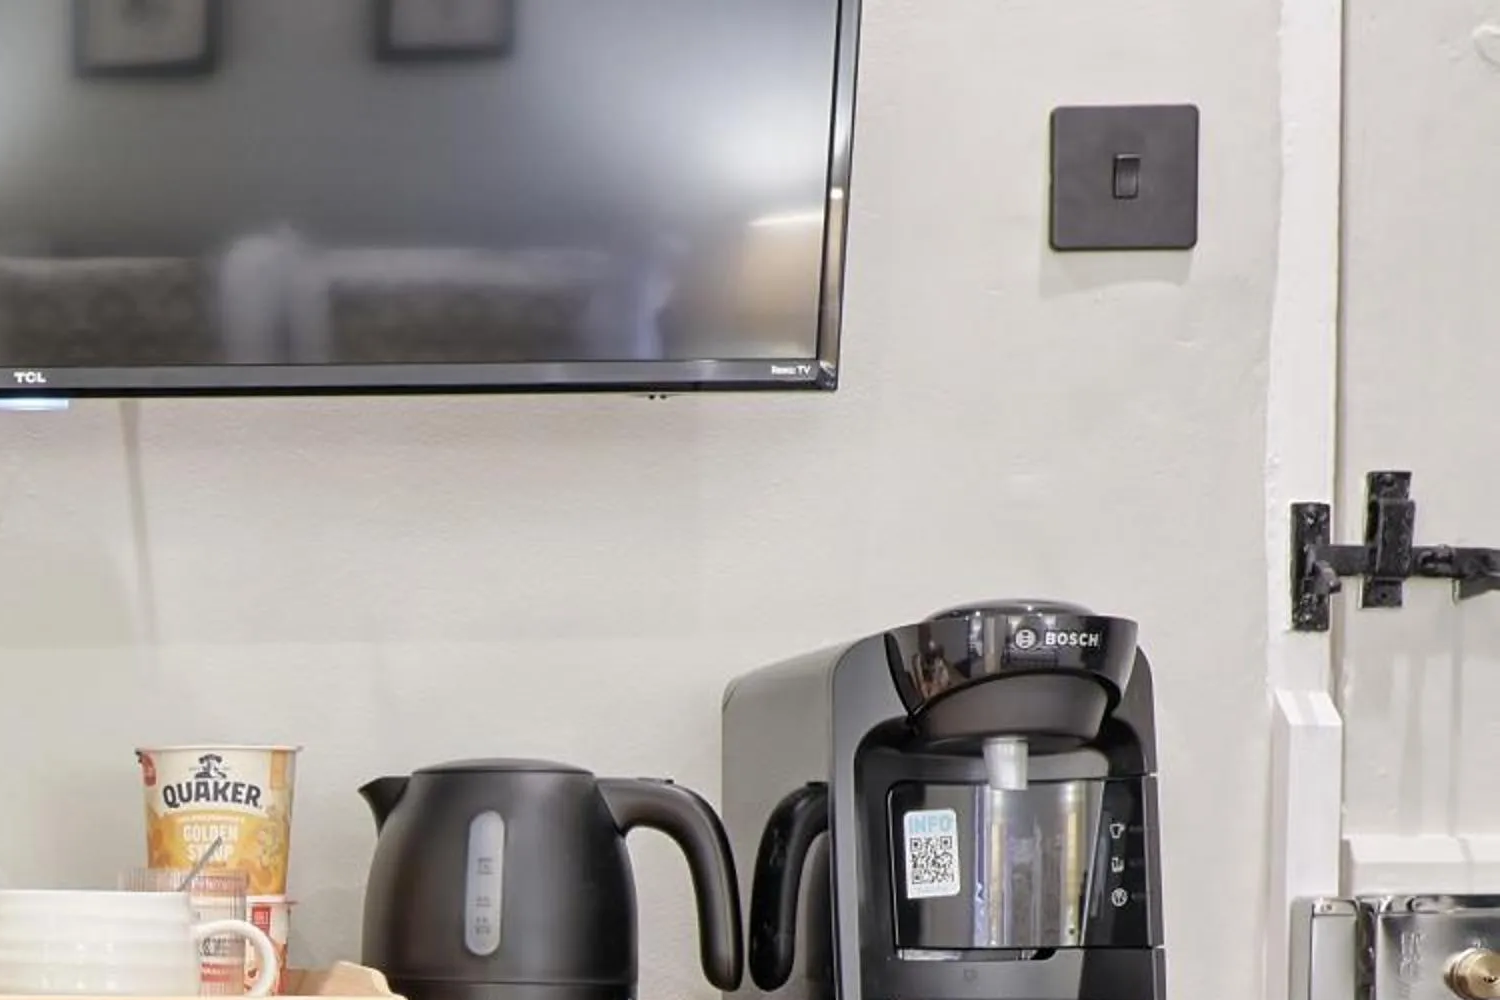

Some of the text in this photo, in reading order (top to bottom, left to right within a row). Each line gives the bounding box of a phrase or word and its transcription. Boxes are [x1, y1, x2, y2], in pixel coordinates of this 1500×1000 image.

[13, 371, 47, 384] TCL
[796, 365, 811, 376] TV
[1045, 631, 1099, 647] BOSCH
[163, 781, 262, 809] QUAKER
[909, 814, 952, 833] INFO
[183, 824, 238, 843] GOLDEN
